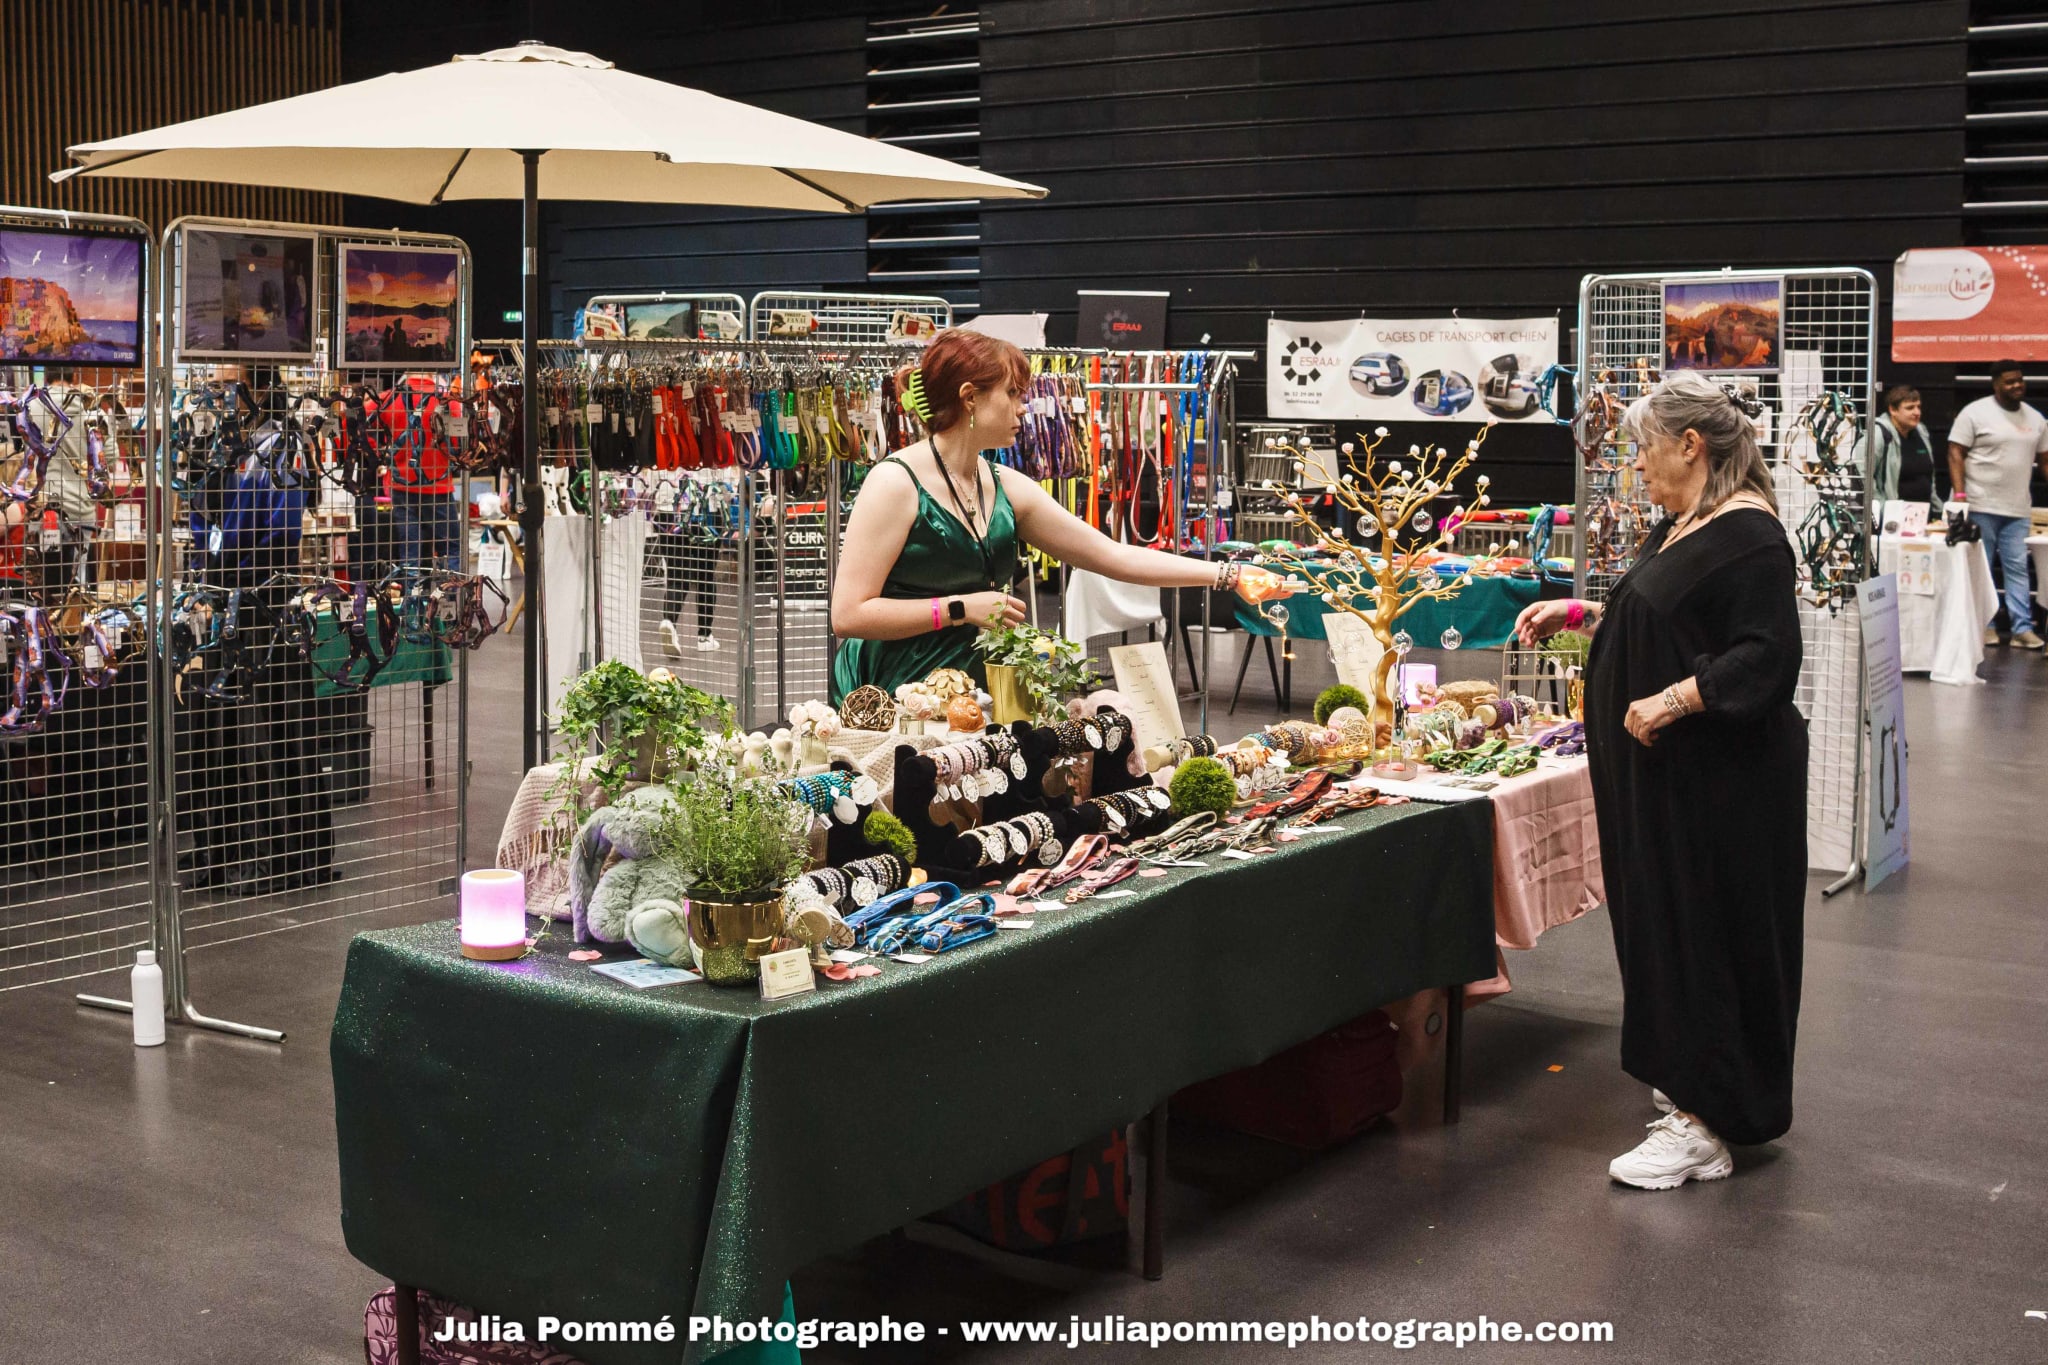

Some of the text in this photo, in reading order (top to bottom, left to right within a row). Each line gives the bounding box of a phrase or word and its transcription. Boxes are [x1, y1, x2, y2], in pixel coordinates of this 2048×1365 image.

[1376, 331, 1547, 343] CAGES DE TRANSPORT CHIEN
